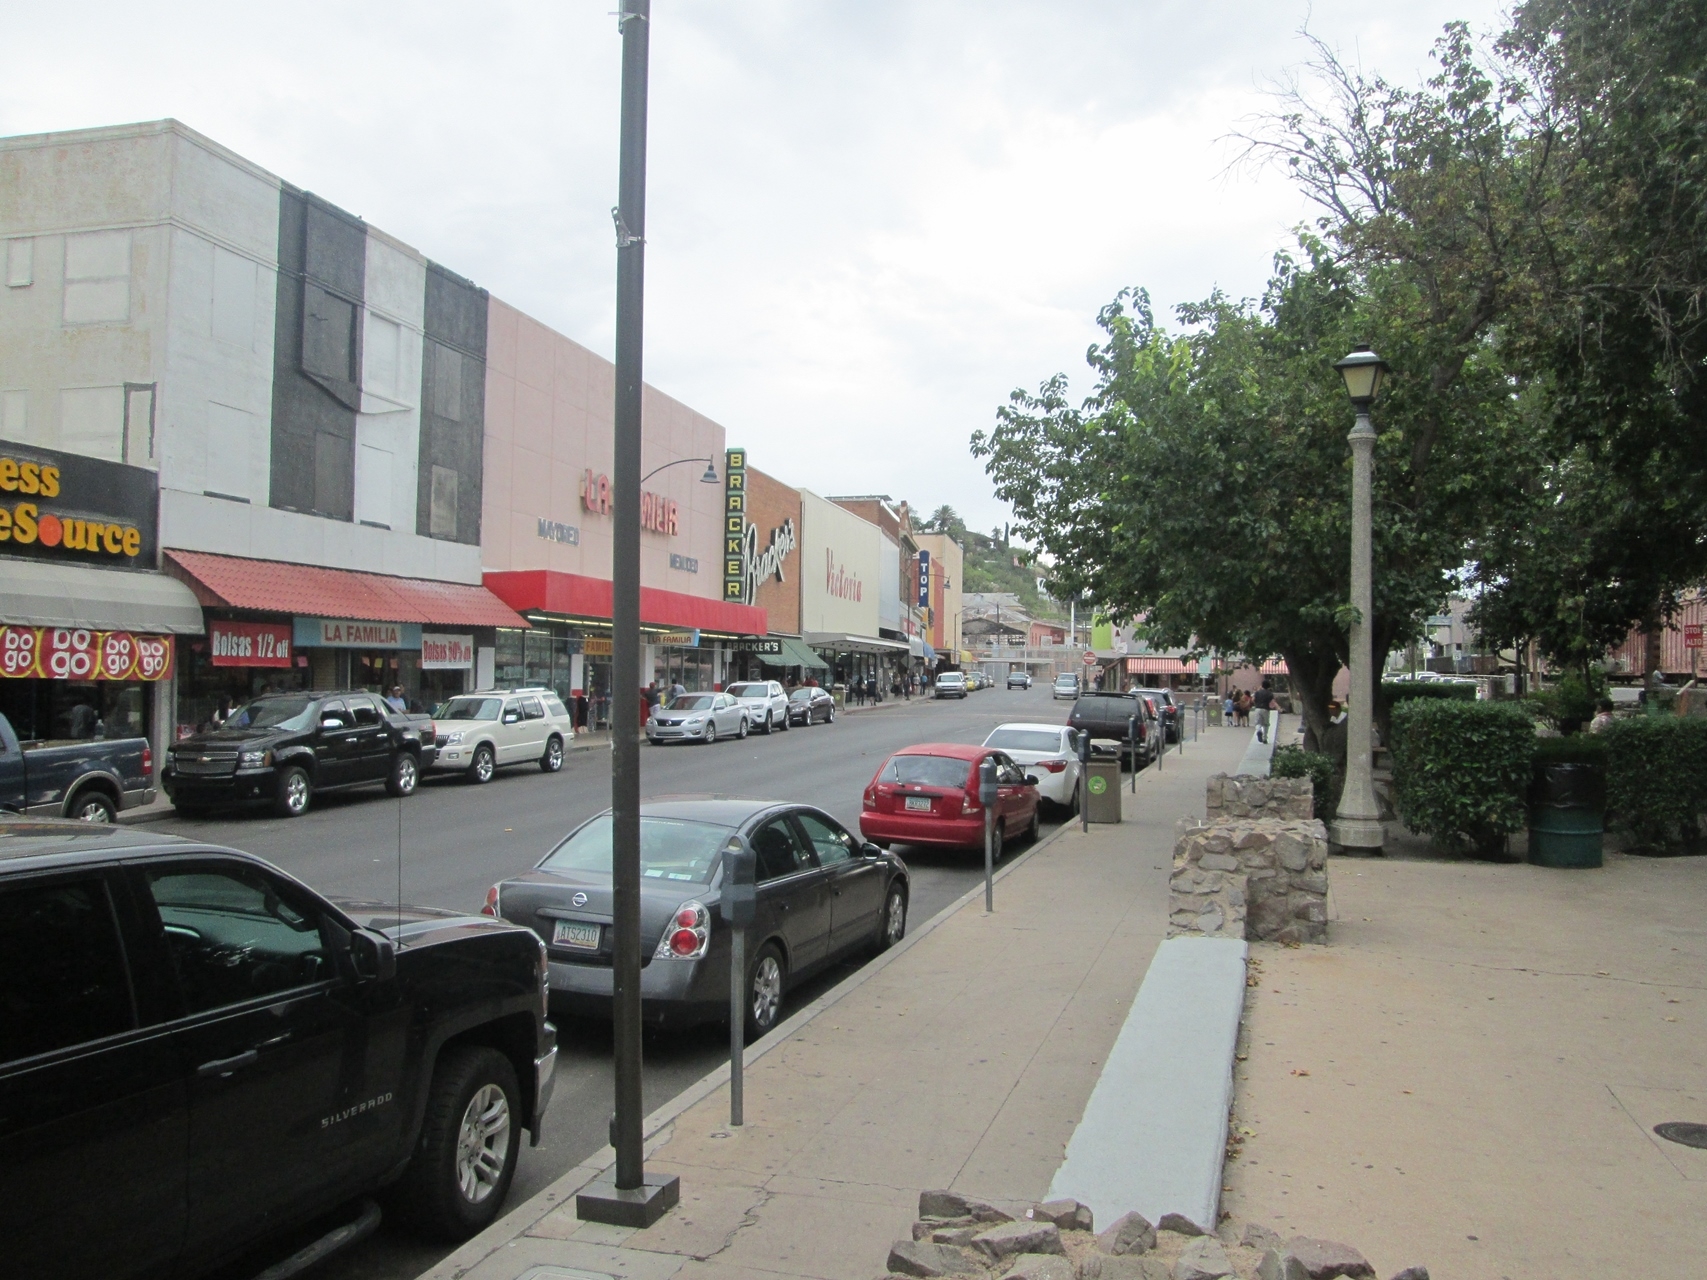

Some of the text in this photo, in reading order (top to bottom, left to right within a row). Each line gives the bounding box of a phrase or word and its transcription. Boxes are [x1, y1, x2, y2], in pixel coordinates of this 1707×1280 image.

[0, 457, 60, 498] ess
[584, 468, 610, 516] LA
[0, 502, 141, 557] eSource
[538, 517, 580, 546] MAYOREO
[727, 453, 743, 596] BRACKER
[826, 547, 862, 603] Victoria
[920, 563, 928, 597] TOP
[5, 629, 34, 649] bo
[212, 631, 289, 659] Bolsas 1/2 off
[324, 624, 398, 644] LA FAMILIA
[651, 635, 692, 645] LA FAMILIA
[1686, 638, 1703, 646] ALTO
[106, 637, 130, 654] bo
[138, 639, 164, 656] bo
[424, 640, 447, 662] Bolsas
[727, 641, 779, 652] BRACKER'S
[4, 650, 32, 672] go
[50, 651, 91, 679] go
[107, 654, 130, 675] go
[143, 657, 164, 676] go
[321, 1092, 394, 1129] SILVERADO
